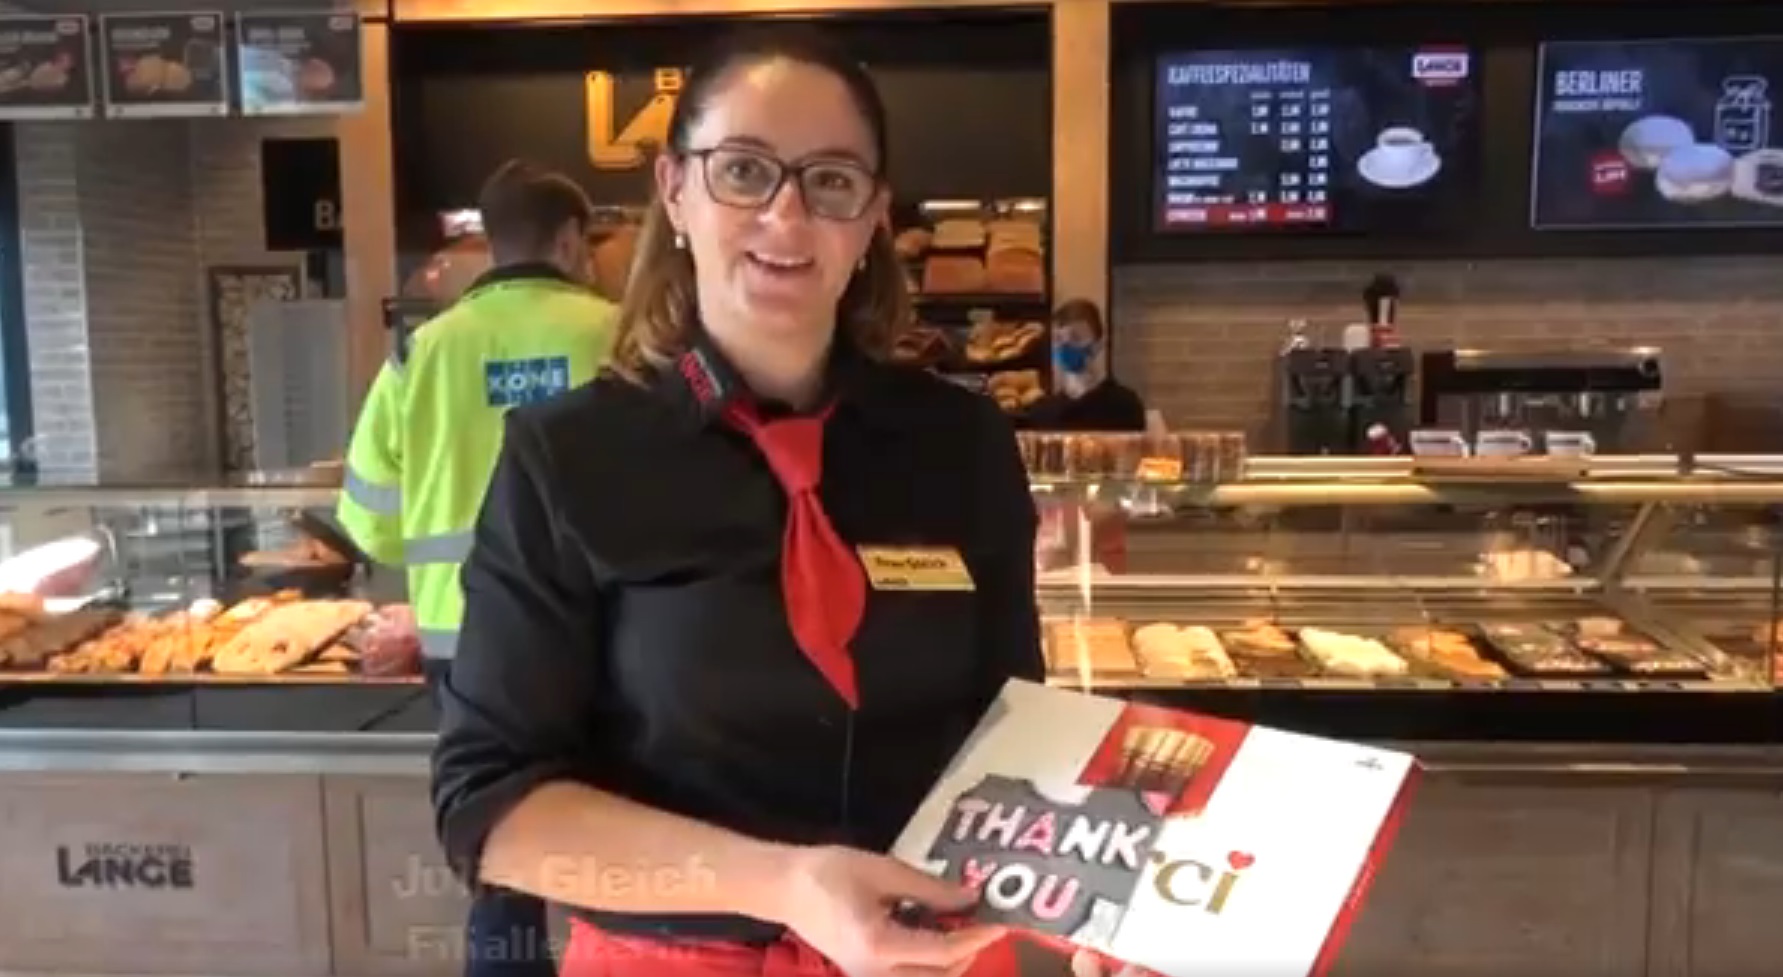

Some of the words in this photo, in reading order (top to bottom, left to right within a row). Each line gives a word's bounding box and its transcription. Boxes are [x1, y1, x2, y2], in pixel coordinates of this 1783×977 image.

[1555, 70, 1643, 96] BERLINER
[954, 798, 1150, 868] THANK
[57, 845, 194, 888] LANGE
[966, 857, 1080, 920] YOU
